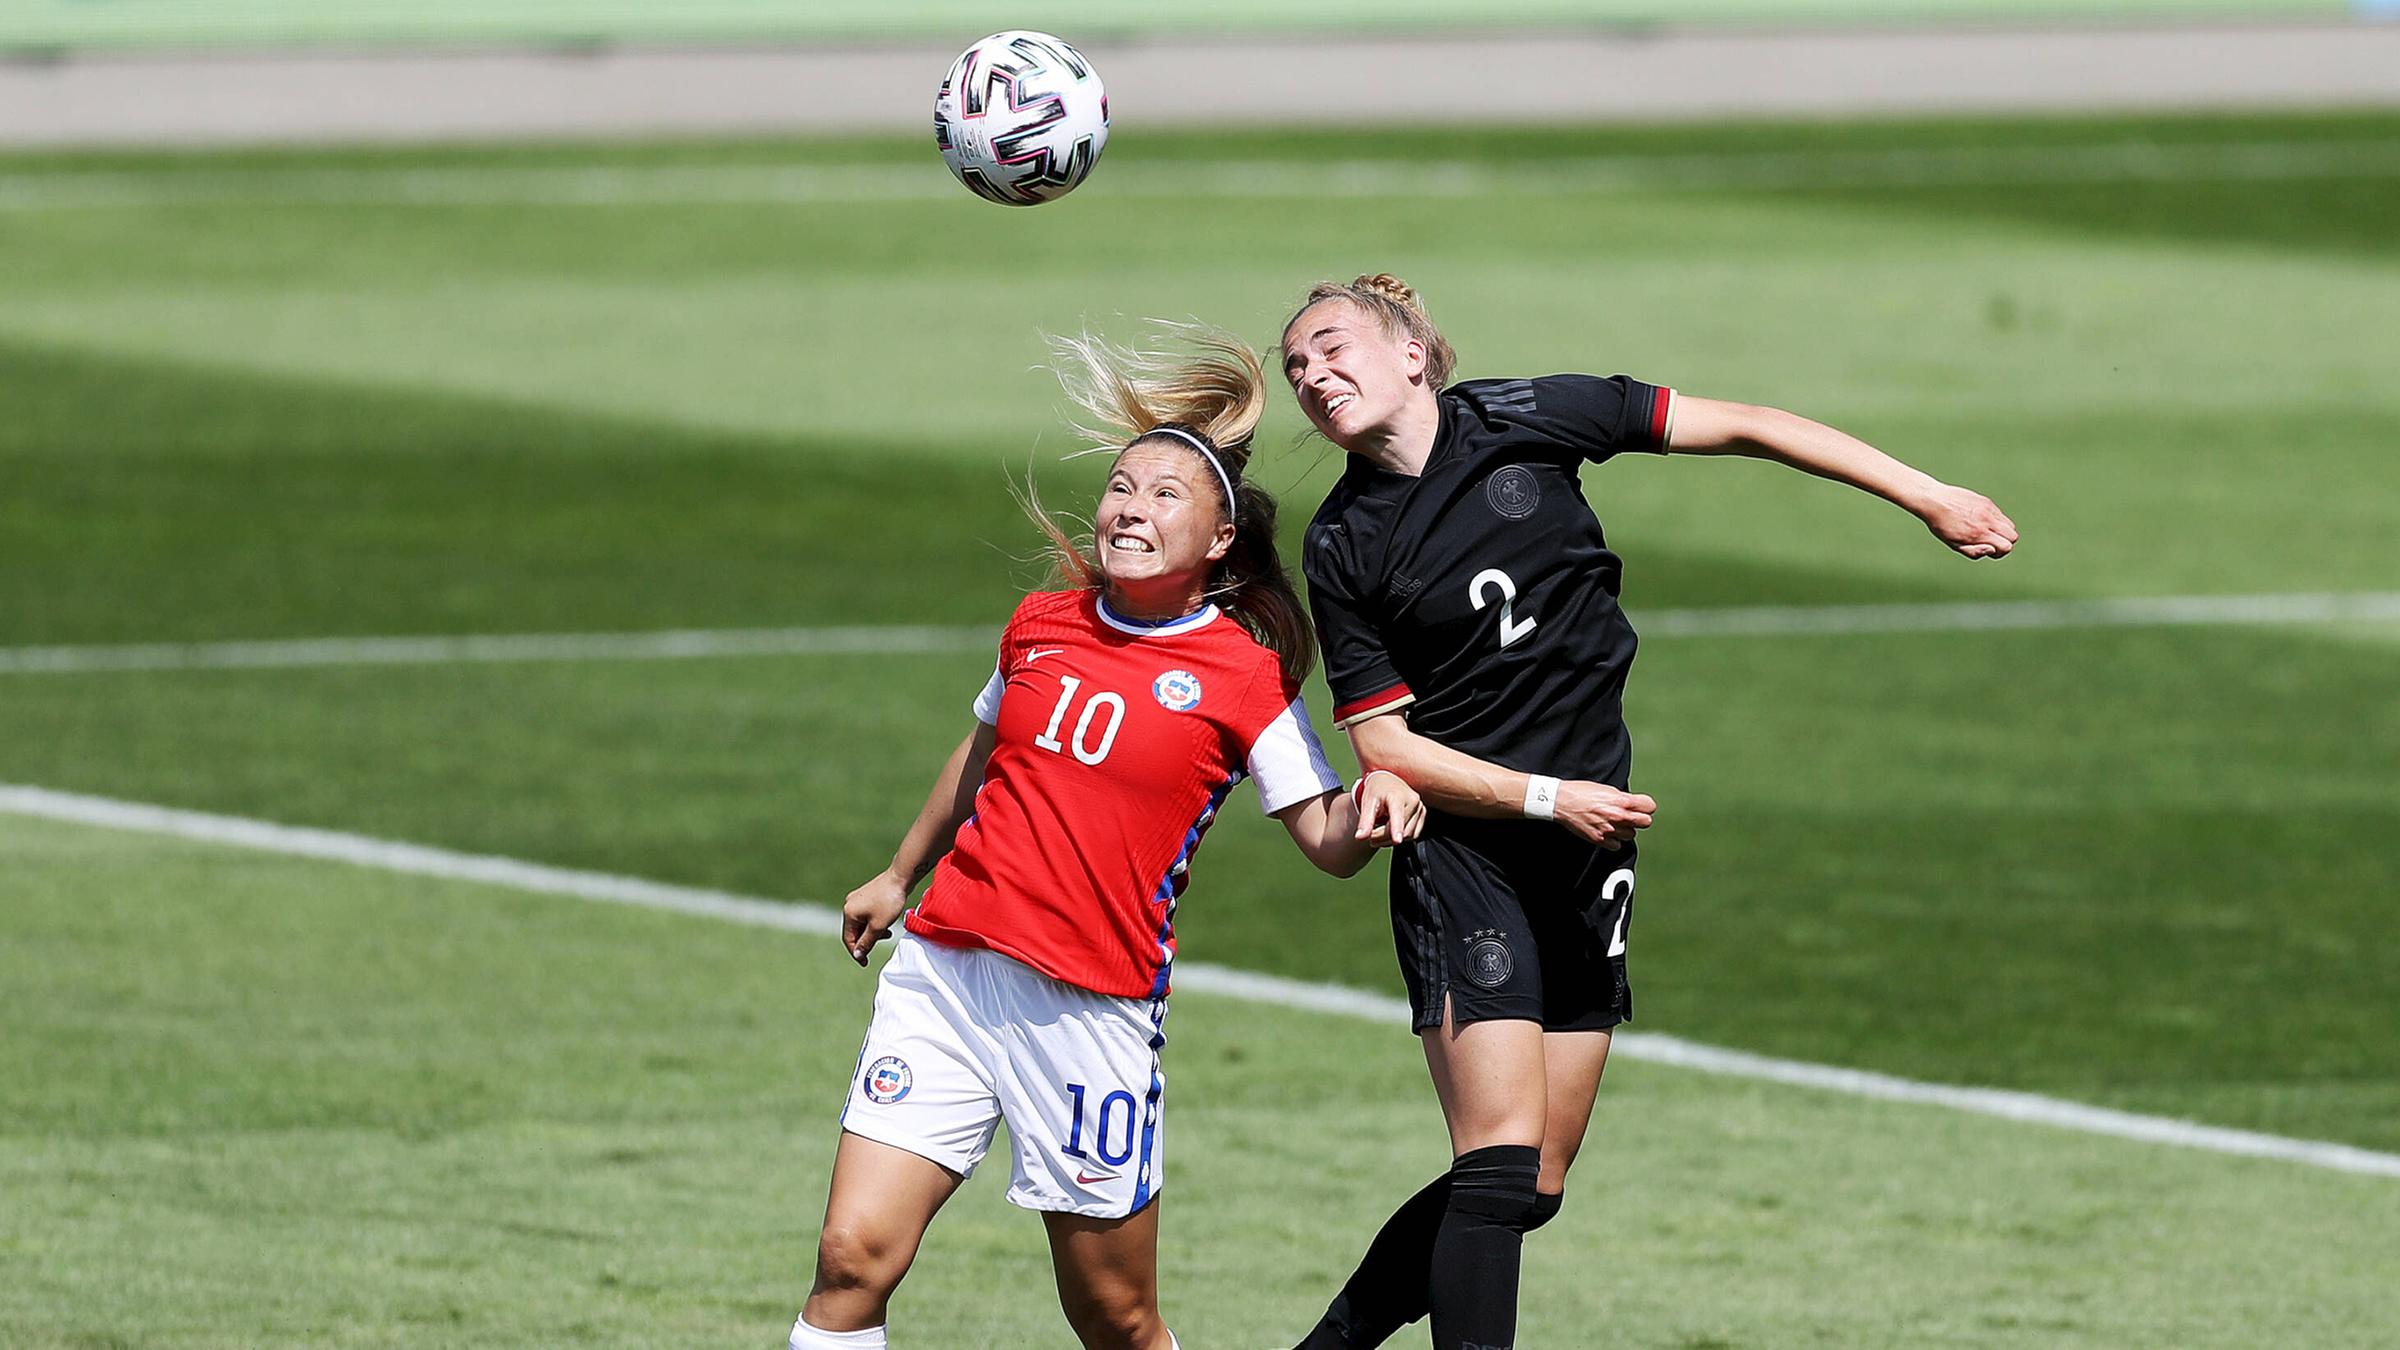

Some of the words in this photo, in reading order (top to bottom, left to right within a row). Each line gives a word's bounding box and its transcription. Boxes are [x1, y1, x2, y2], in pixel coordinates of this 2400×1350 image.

[1468, 568, 1538, 649] 2
[1035, 675, 1126, 767] 10
[1601, 868, 1635, 957] 2
[1061, 1083, 1137, 1167] 10
